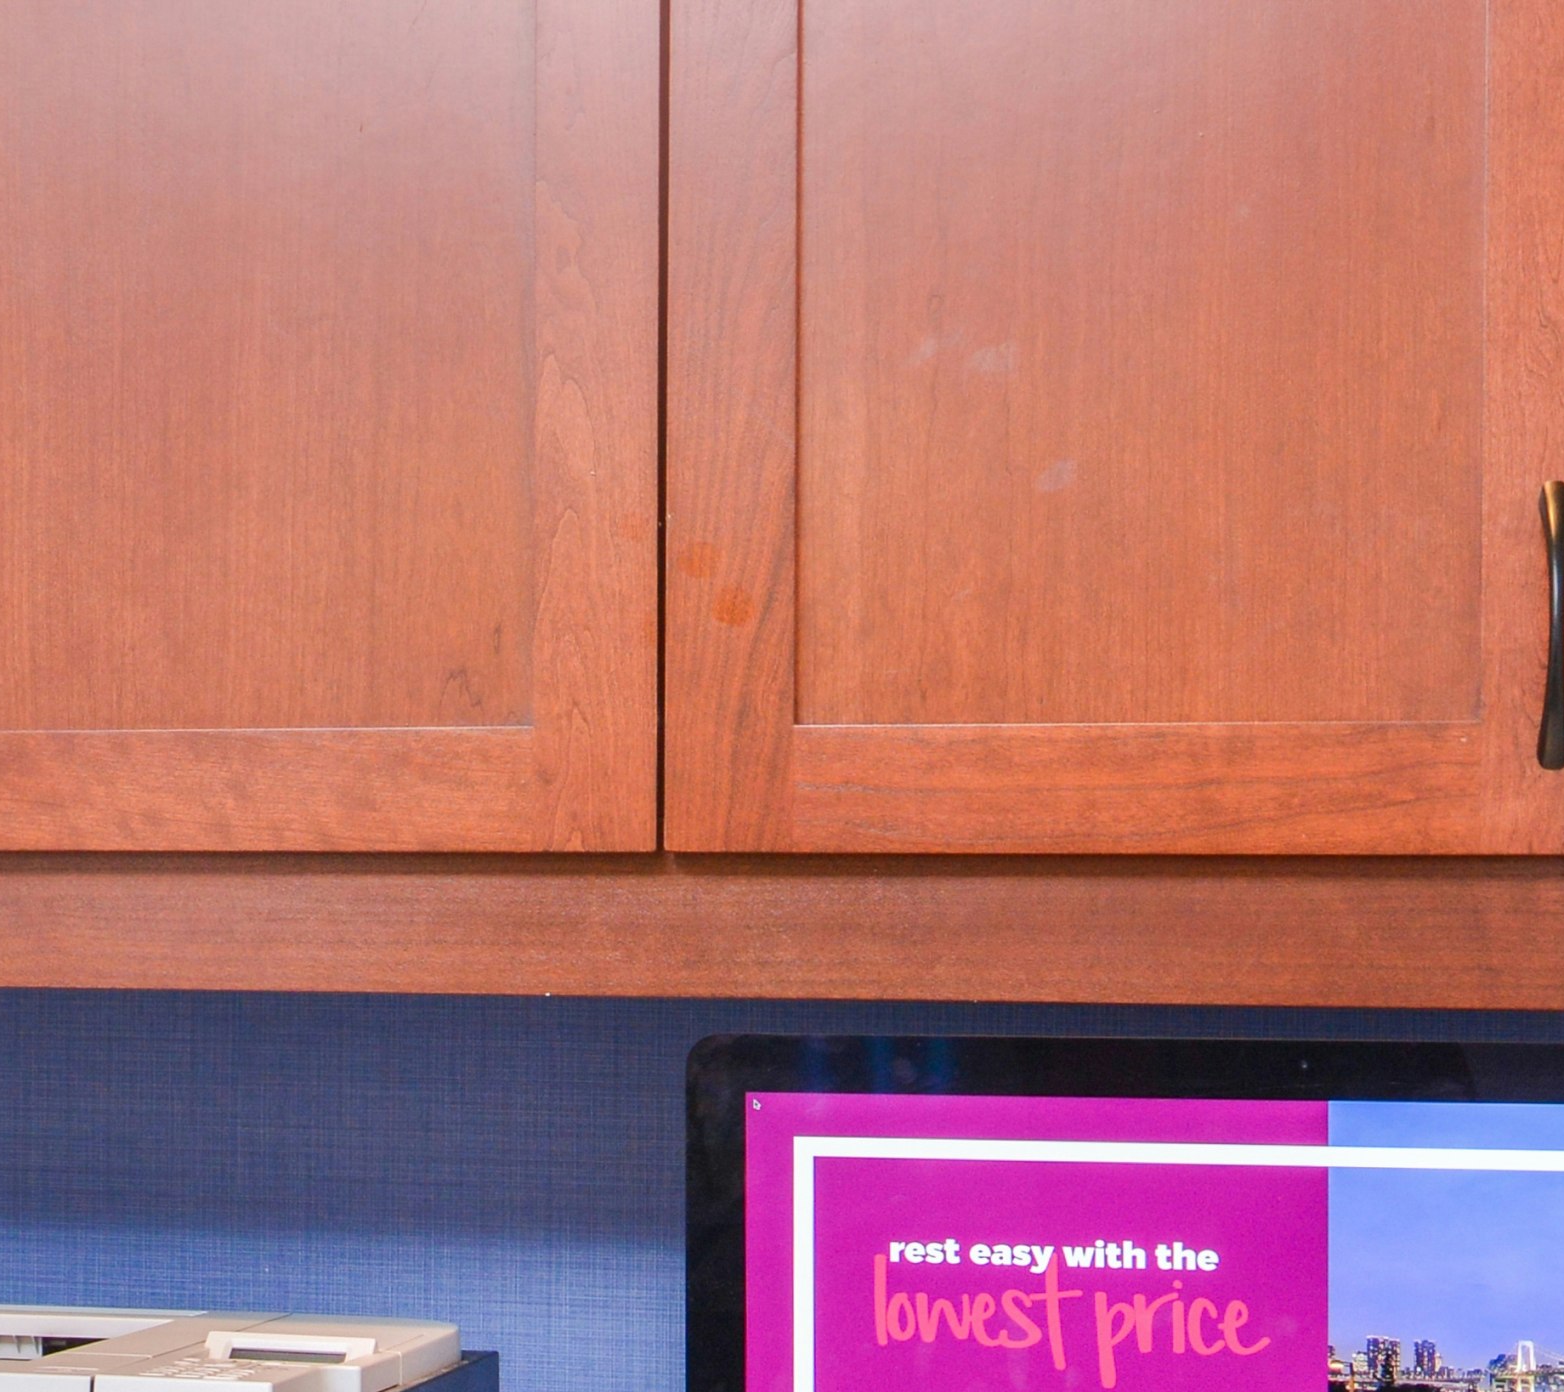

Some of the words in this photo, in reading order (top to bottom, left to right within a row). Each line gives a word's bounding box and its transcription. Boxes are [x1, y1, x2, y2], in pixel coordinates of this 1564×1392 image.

[889, 1238, 961, 1266] rest
[969, 1240, 1056, 1274] easy
[1063, 1238, 1147, 1270] with
[1155, 1241, 1220, 1272] the
[874, 1252, 1084, 1371] lowest
[1094, 1279, 1272, 1389] price
